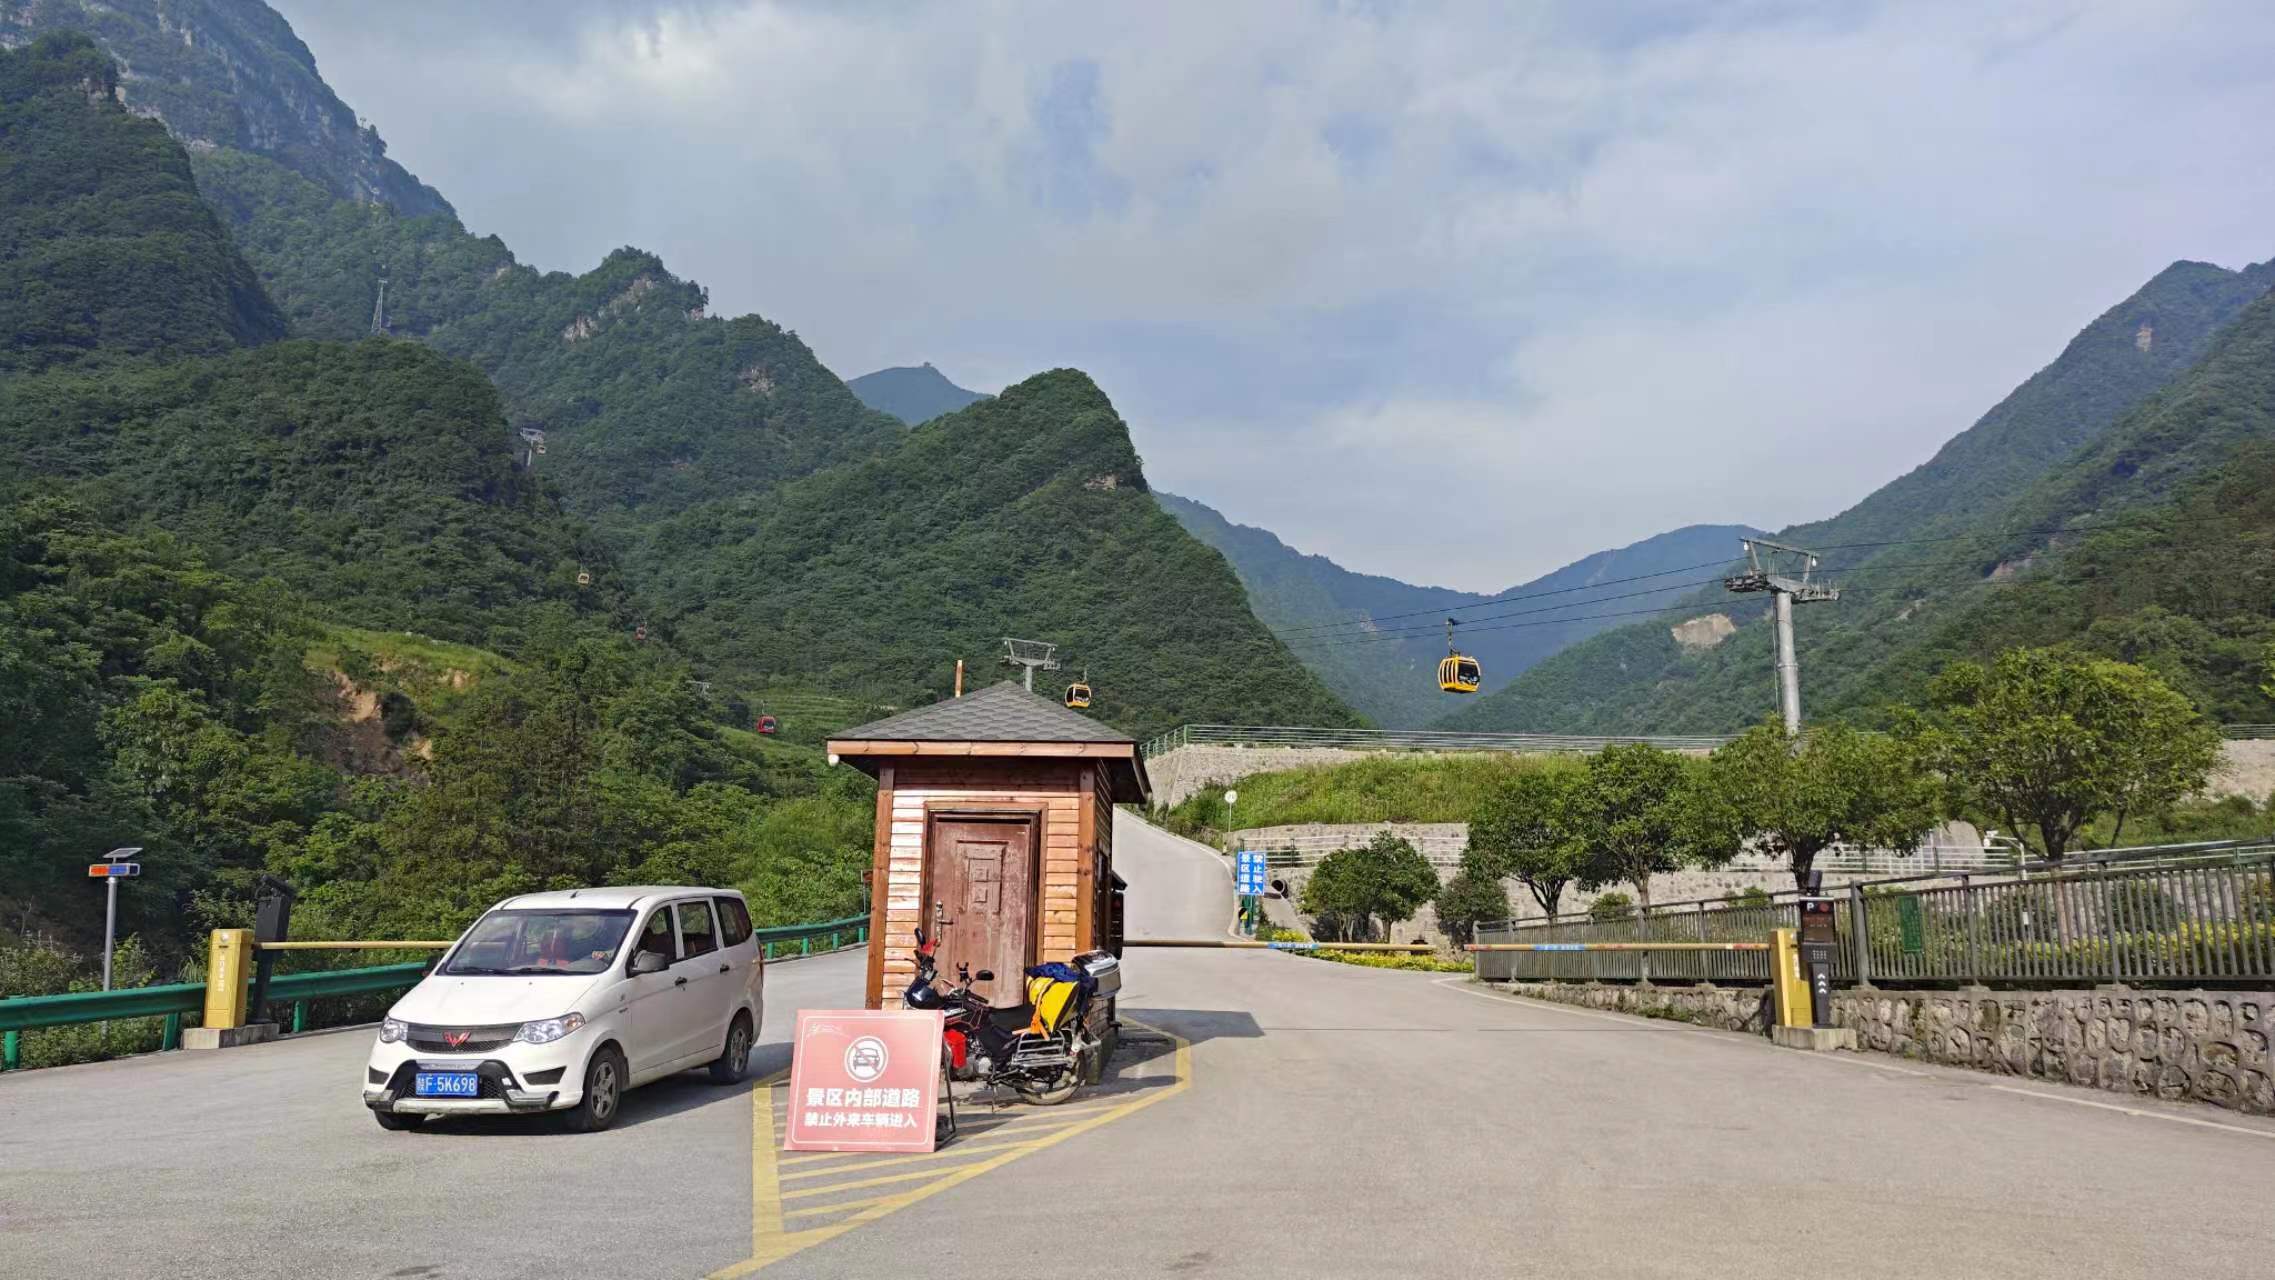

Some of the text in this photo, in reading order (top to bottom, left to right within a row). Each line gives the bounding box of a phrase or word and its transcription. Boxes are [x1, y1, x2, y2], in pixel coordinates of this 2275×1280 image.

[1806, 902, 1815, 912] P
[806, 1087, 920, 1108] 景区内部道路
[804, 1112, 917, 1128] 禁止外来车辆进入
